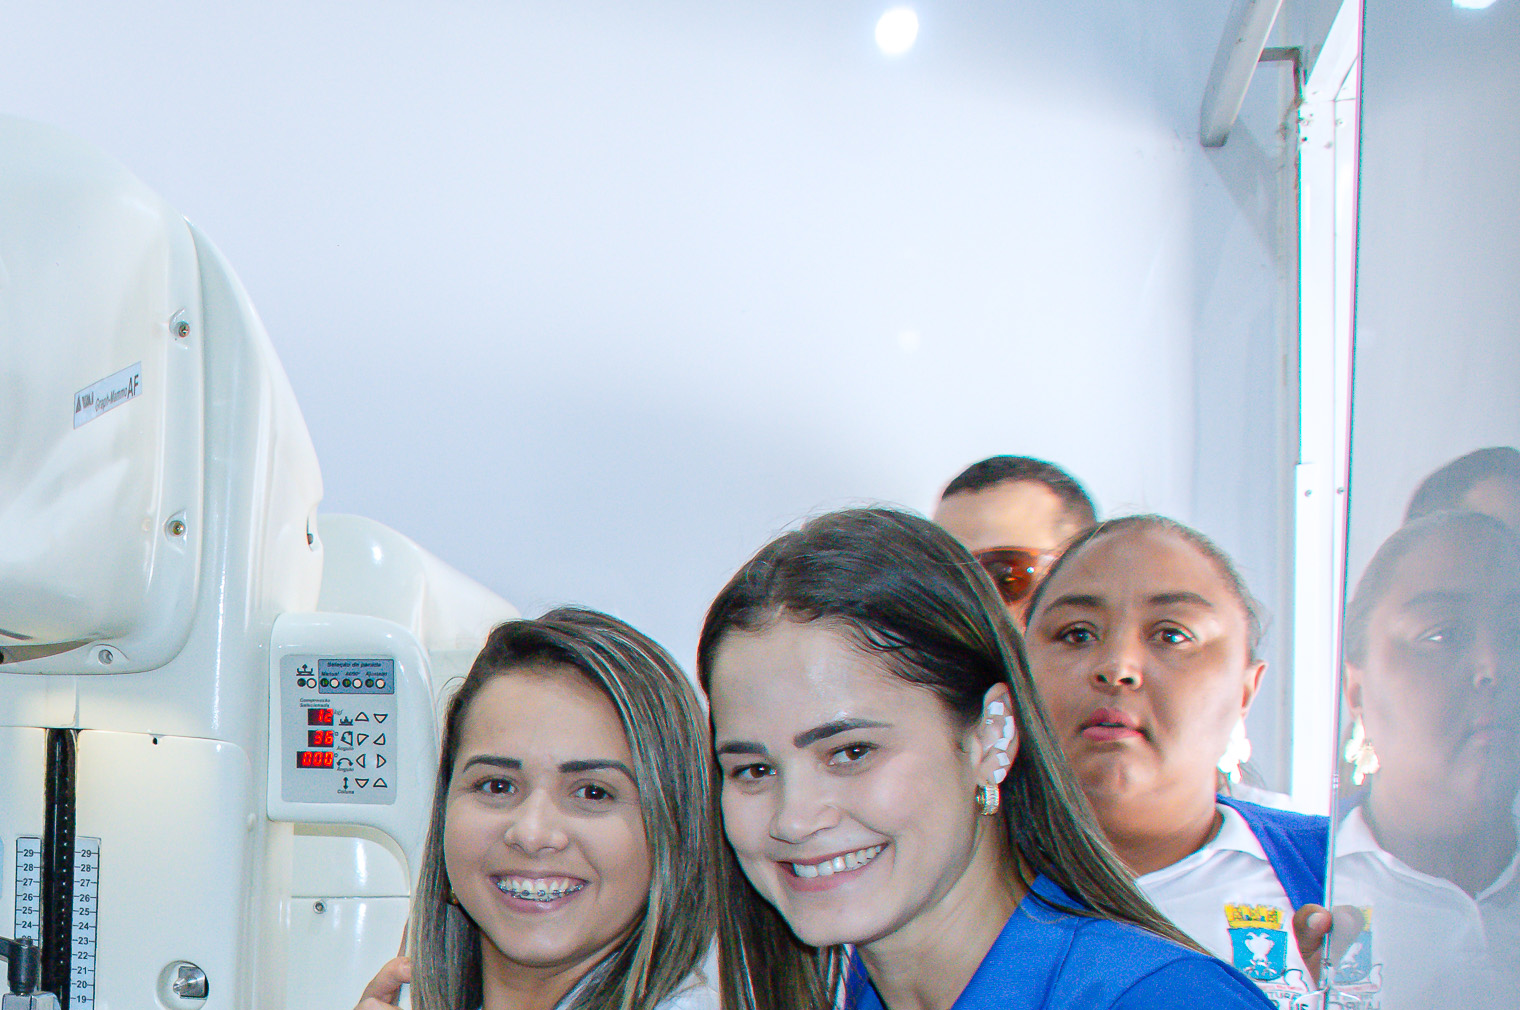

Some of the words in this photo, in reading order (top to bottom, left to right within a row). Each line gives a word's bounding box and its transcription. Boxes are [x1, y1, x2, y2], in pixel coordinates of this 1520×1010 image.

[127, 373, 139, 399] AF
[318, 708, 333, 723] 12
[313, 730, 333, 745] 36
[302, 751, 333, 767] 000
[23, 849, 34, 857] 29
[23, 864, 34, 872] 28
[80, 864, 91, 872] 28
[22, 878, 33, 886] 27
[80, 879, 90, 887] 27
[22, 893, 33, 901] 26
[79, 894, 90, 902] 26
[22, 906, 33, 914] 25
[21, 921, 32, 929] 24
[78, 922, 89, 930] 24
[78, 937, 89, 945] 23
